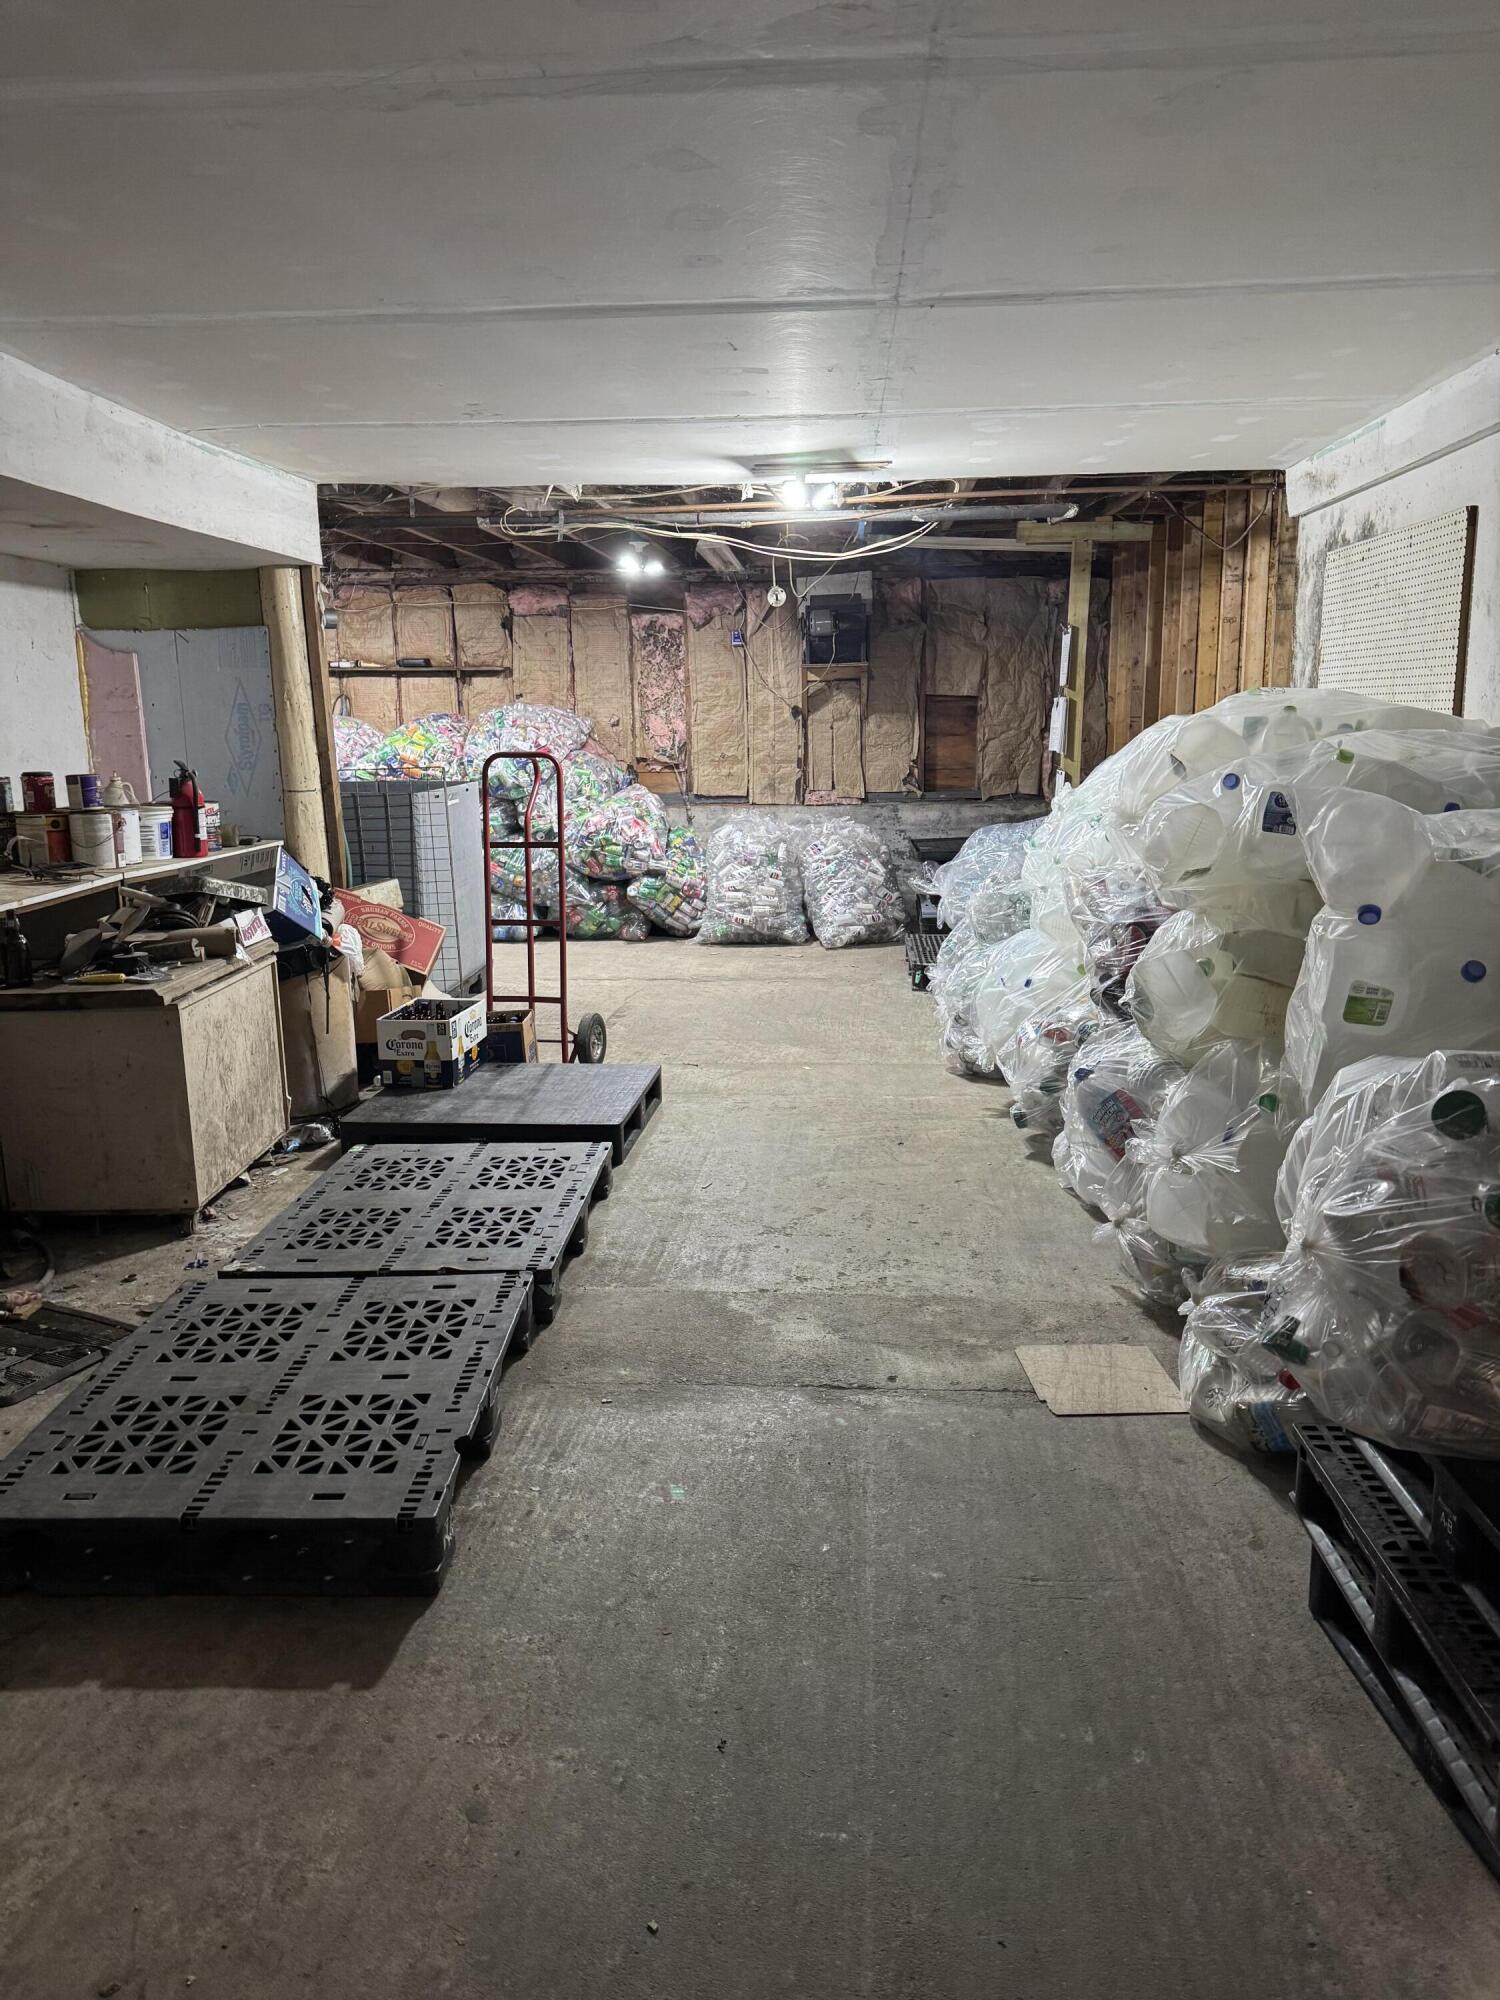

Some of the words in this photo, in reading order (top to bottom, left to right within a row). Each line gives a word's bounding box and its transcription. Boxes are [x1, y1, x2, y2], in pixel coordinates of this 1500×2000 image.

[234, 702, 254, 771] Styrofoam
[418, 921, 442, 934] QUALITY
[385, 1039, 424, 1050] Corona
[394, 1049, 415, 1057] Extra
